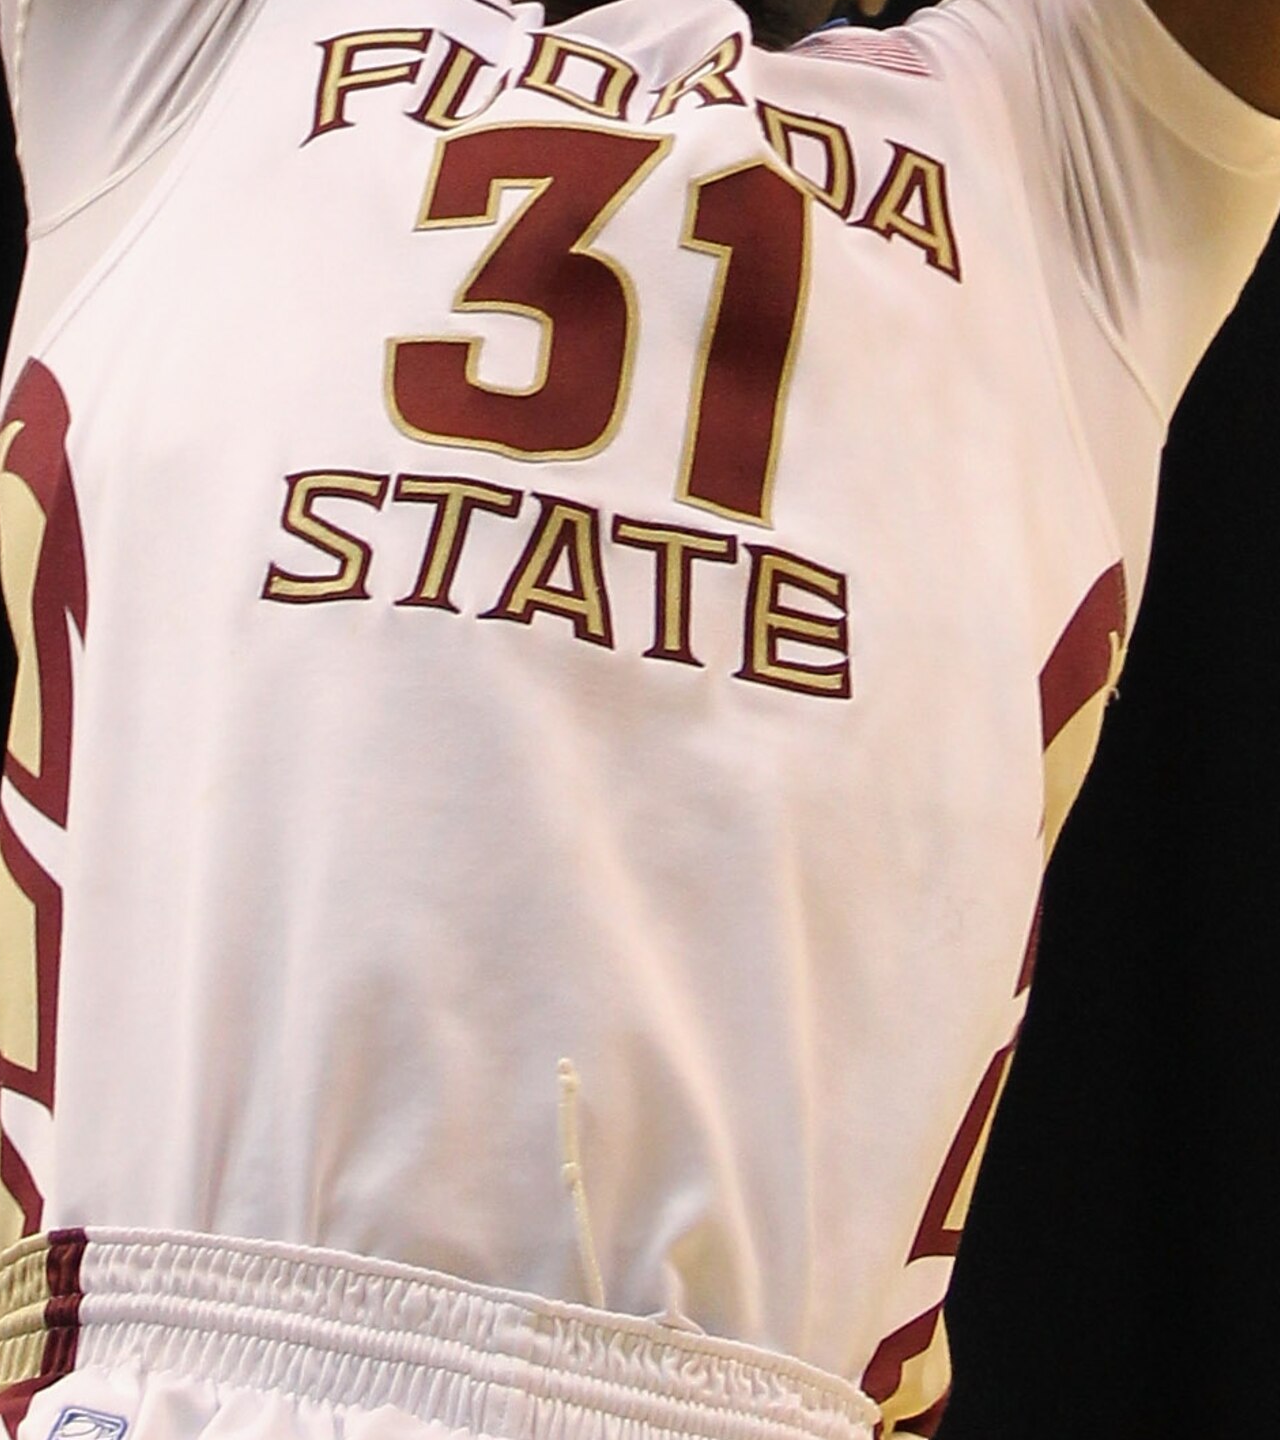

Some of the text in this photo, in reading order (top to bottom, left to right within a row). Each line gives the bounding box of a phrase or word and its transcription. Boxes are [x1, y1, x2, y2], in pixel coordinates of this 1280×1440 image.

[301, 28, 962, 283] FLORDA
[384, 120, 814, 528] 31
[261, 468, 853, 699] STATE
